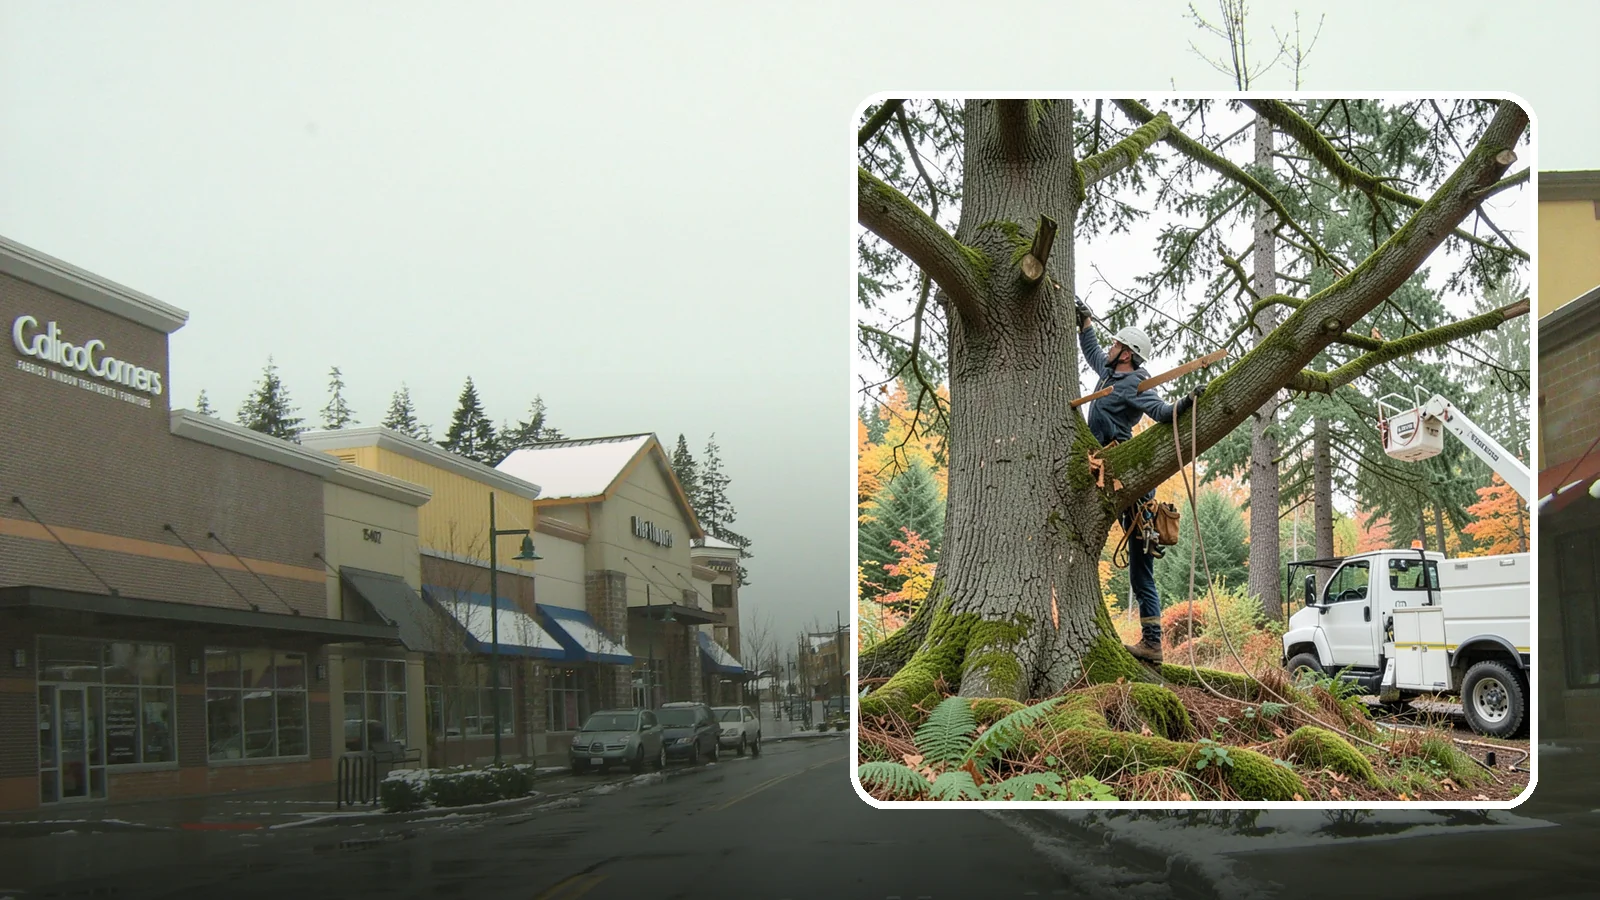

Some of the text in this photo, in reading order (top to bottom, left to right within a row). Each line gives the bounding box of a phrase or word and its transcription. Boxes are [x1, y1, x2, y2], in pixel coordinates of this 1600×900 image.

[17, 360, 151, 408] FABRICS WINDOW TREATMENTS FURNITURE
